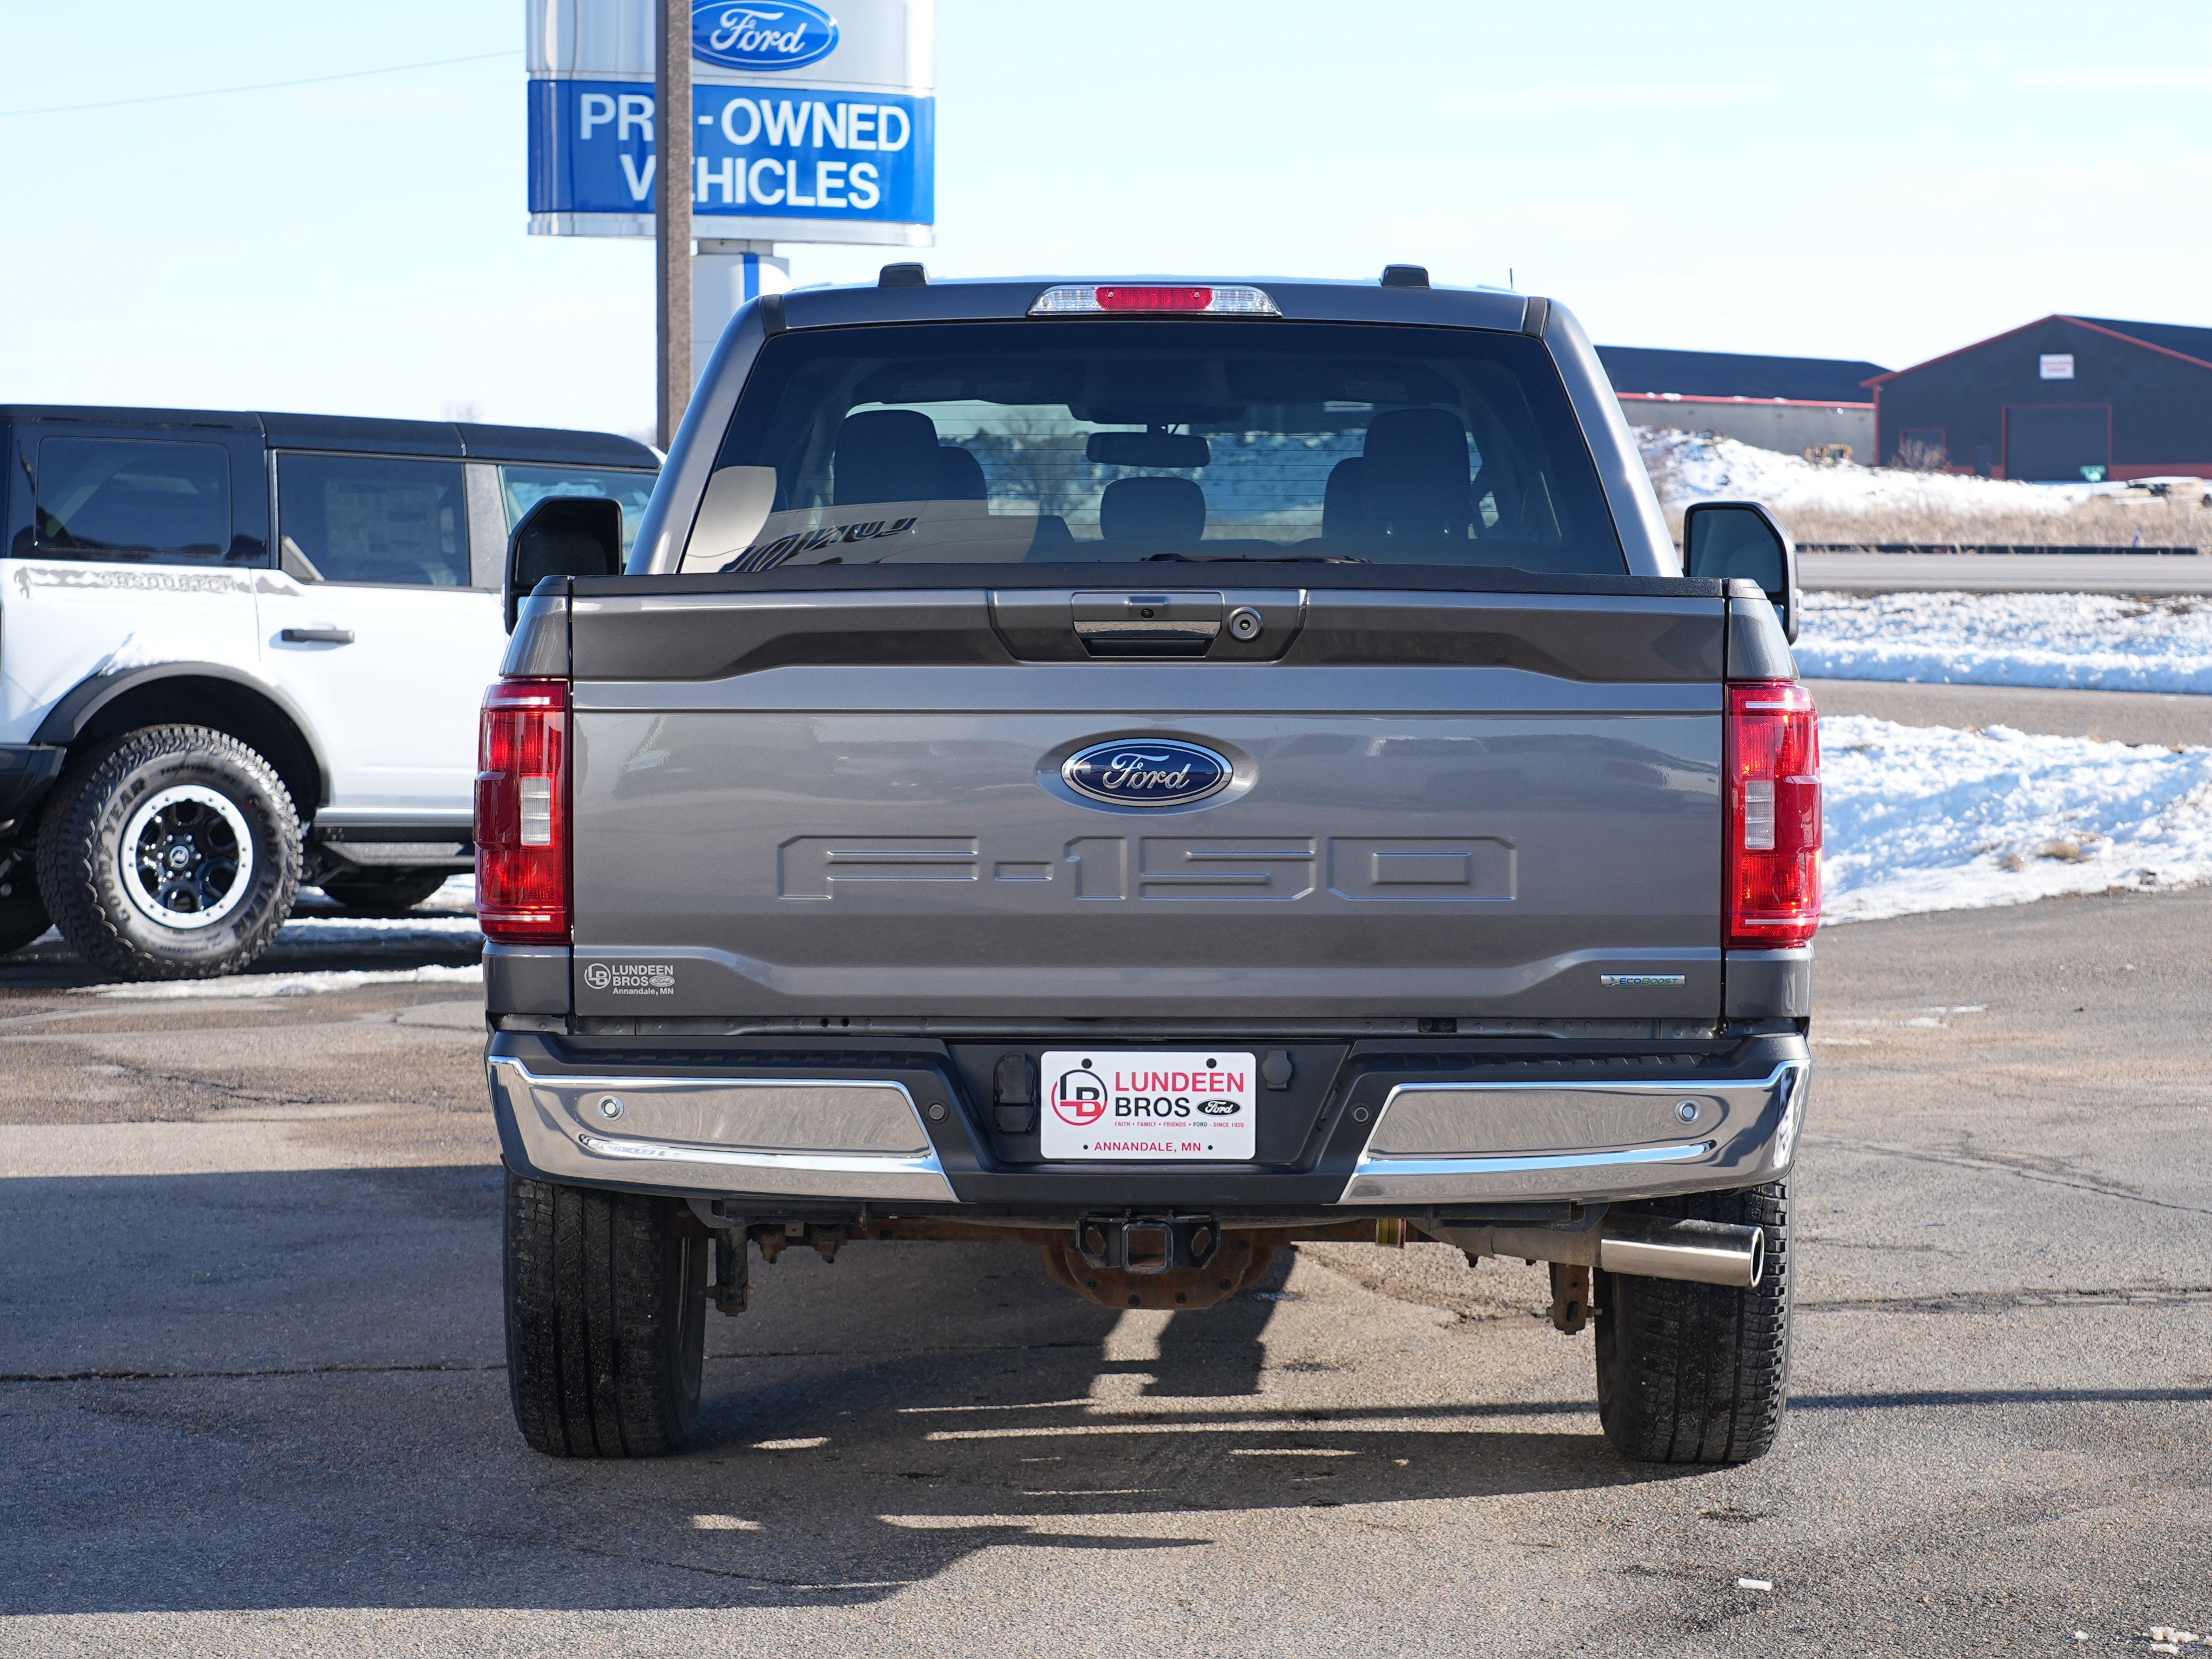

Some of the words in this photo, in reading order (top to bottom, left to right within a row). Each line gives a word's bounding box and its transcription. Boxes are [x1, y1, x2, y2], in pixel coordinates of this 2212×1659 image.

[710, 8, 807, 53] Ford
[581, 93, 911, 152] PR-OWNED
[621, 154, 880, 209] VHICLES
[99, 571, 238, 592] SASQUATCH
[1102, 752, 1190, 792] Ford
[778, 835, 1516, 901] F-150
[612, 965, 673, 975] LUNDEEN
[612, 976, 649, 986] BROS
[612, 987, 658, 995] Annandale,
[1115, 1072, 1244, 1092] LUNDEEN
[1115, 1097, 1190, 1117] BROS
[1204, 1101, 1233, 1115] Ford
[1094, 1143, 1177, 1153] ANNANDALE,
[1181, 1143, 1202, 1151] MN
